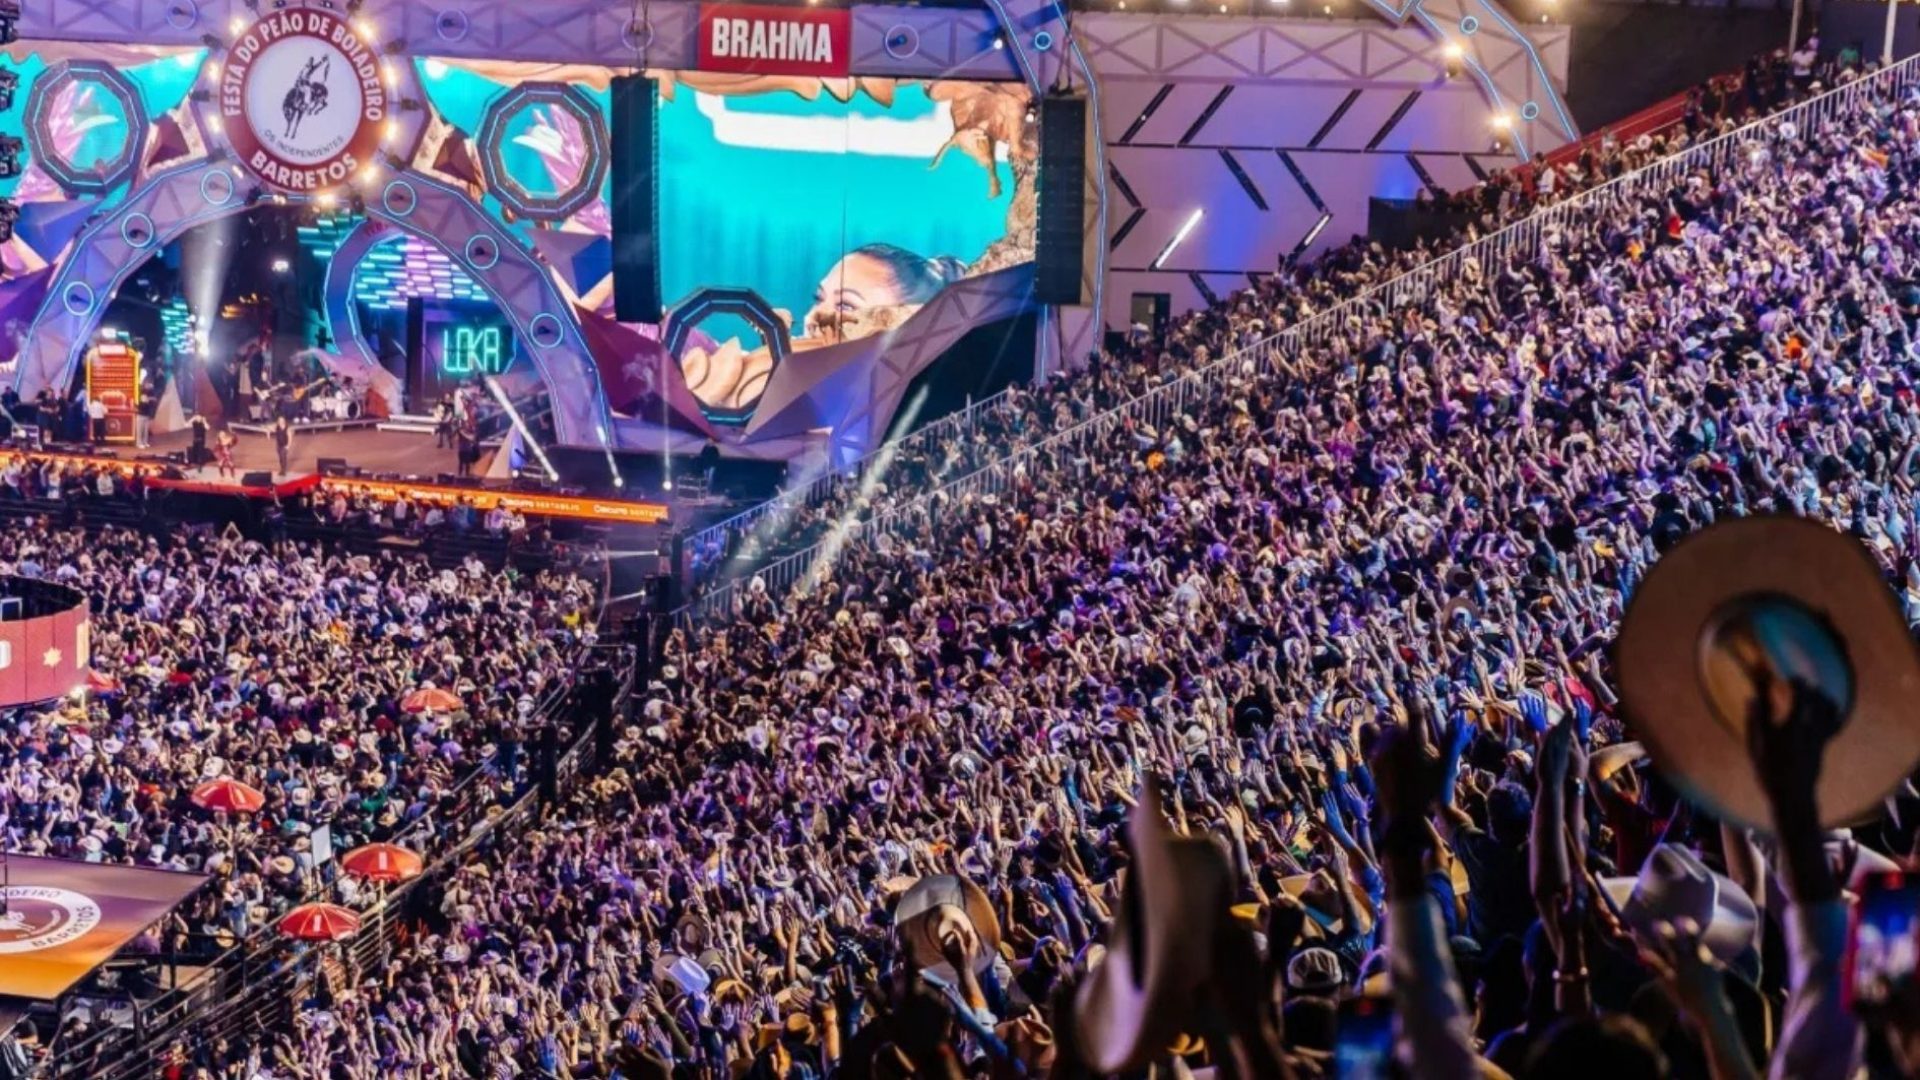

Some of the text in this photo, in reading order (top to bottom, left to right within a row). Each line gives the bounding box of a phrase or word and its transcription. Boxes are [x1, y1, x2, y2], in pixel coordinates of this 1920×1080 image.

[712, 17, 833, 63] BRAHMA
[224, 11, 383, 121] FESTA DO PEÃO DE BOIADEIRO
[264, 130, 344, 158] OS INDEPENDENTES
[251, 150, 357, 189] BARRETOS
[443, 327, 499, 372] LOKA
[31, 905, 95, 947] BARRETOS
